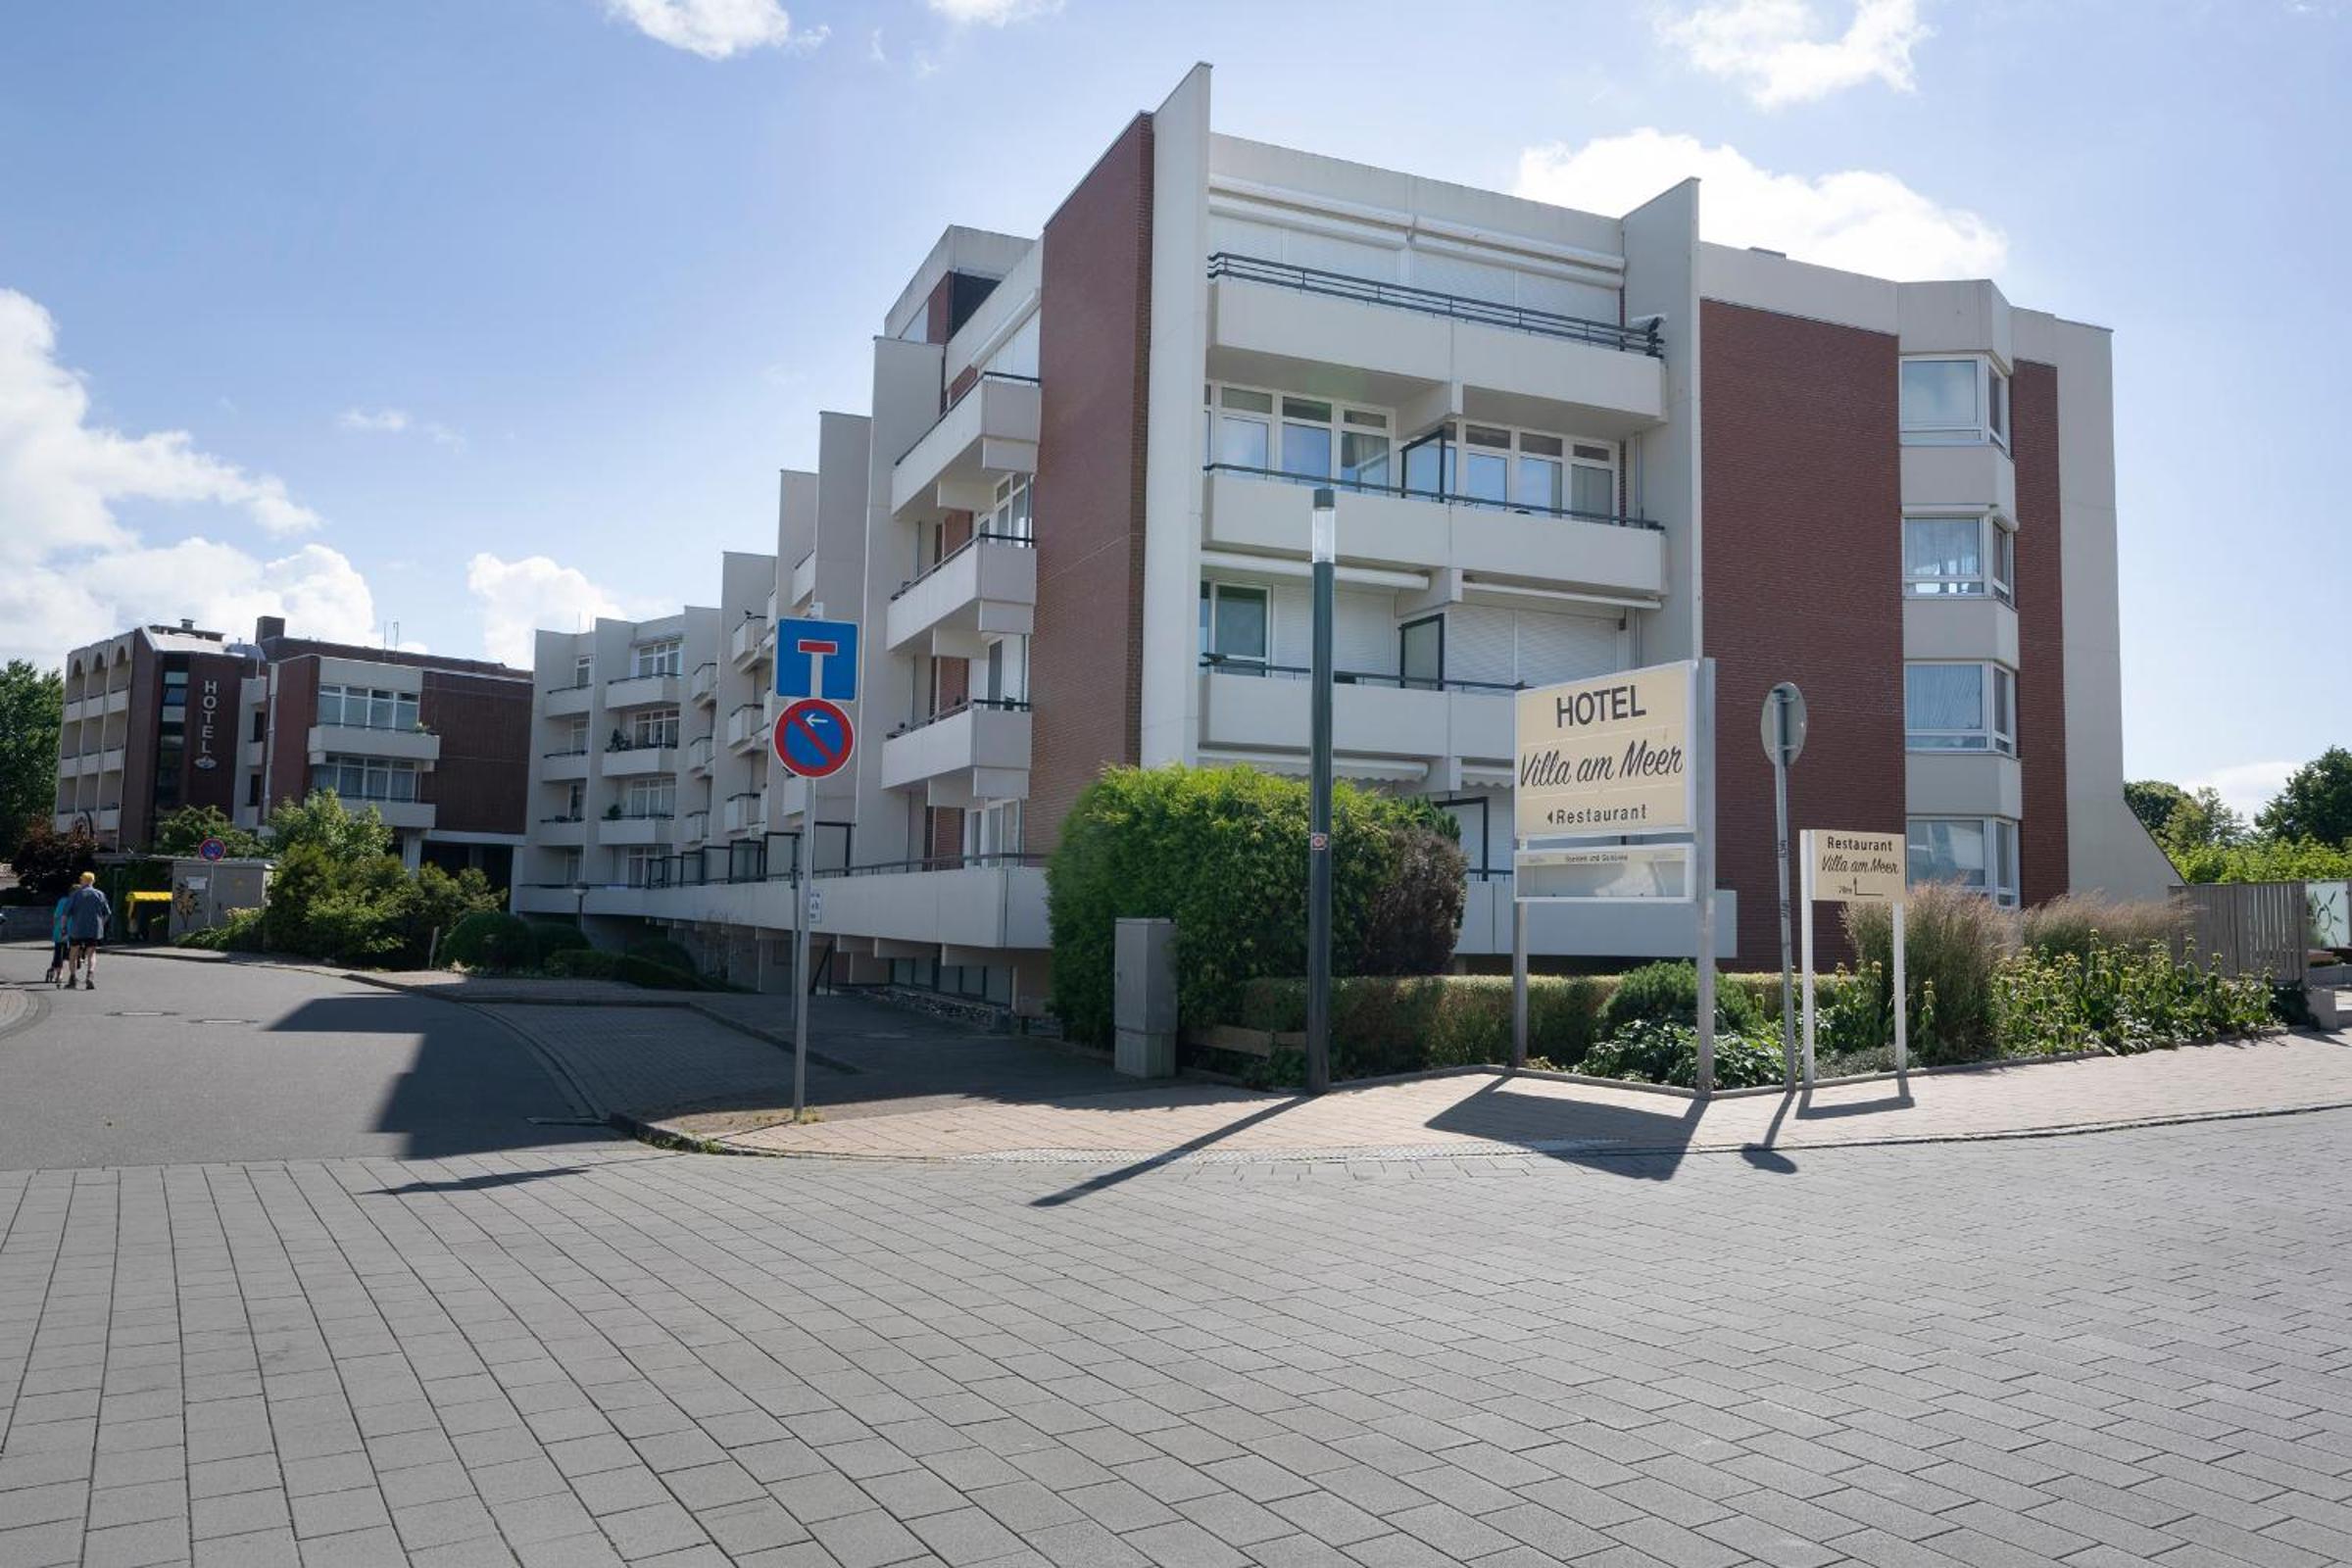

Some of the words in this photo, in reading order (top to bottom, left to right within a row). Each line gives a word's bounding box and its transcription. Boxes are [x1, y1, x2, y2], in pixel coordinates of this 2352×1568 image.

[201, 680, 218, 754] HOTEL
[1556, 685, 1646, 728] HOTEL
[1520, 750, 1572, 788] Villa
[1577, 755, 1615, 783] am
[1619, 739, 1685, 778] Meer
[1555, 804, 1646, 825] Restaurant
[1828, 836, 1893, 852] Restaurant
[1821, 854, 1849, 873] Villa
[1850, 860, 1868, 873] am
[1867, 858, 1899, 875] Meer
